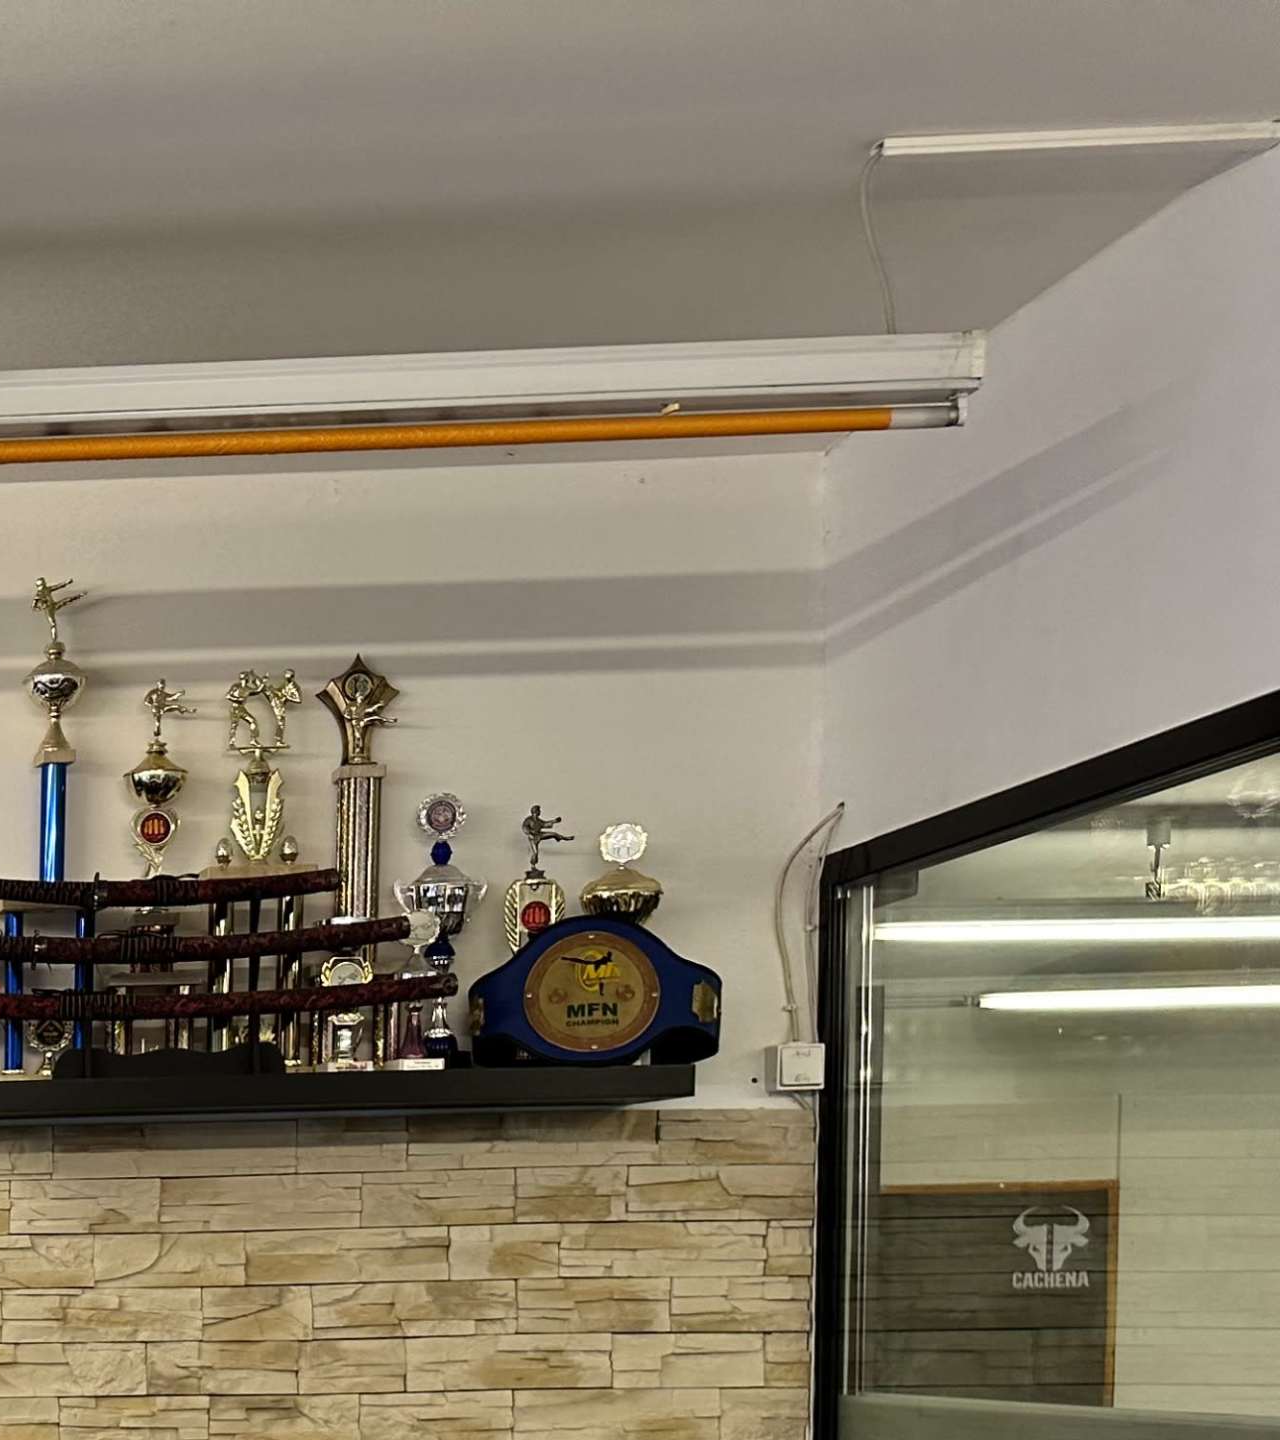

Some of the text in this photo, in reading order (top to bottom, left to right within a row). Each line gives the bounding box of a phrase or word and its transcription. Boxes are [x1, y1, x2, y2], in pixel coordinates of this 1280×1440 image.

[566, 1003, 618, 1018] MFN
[565, 1018, 620, 1027] CHAMPION
[1012, 1271, 1089, 1289] CACHENA
